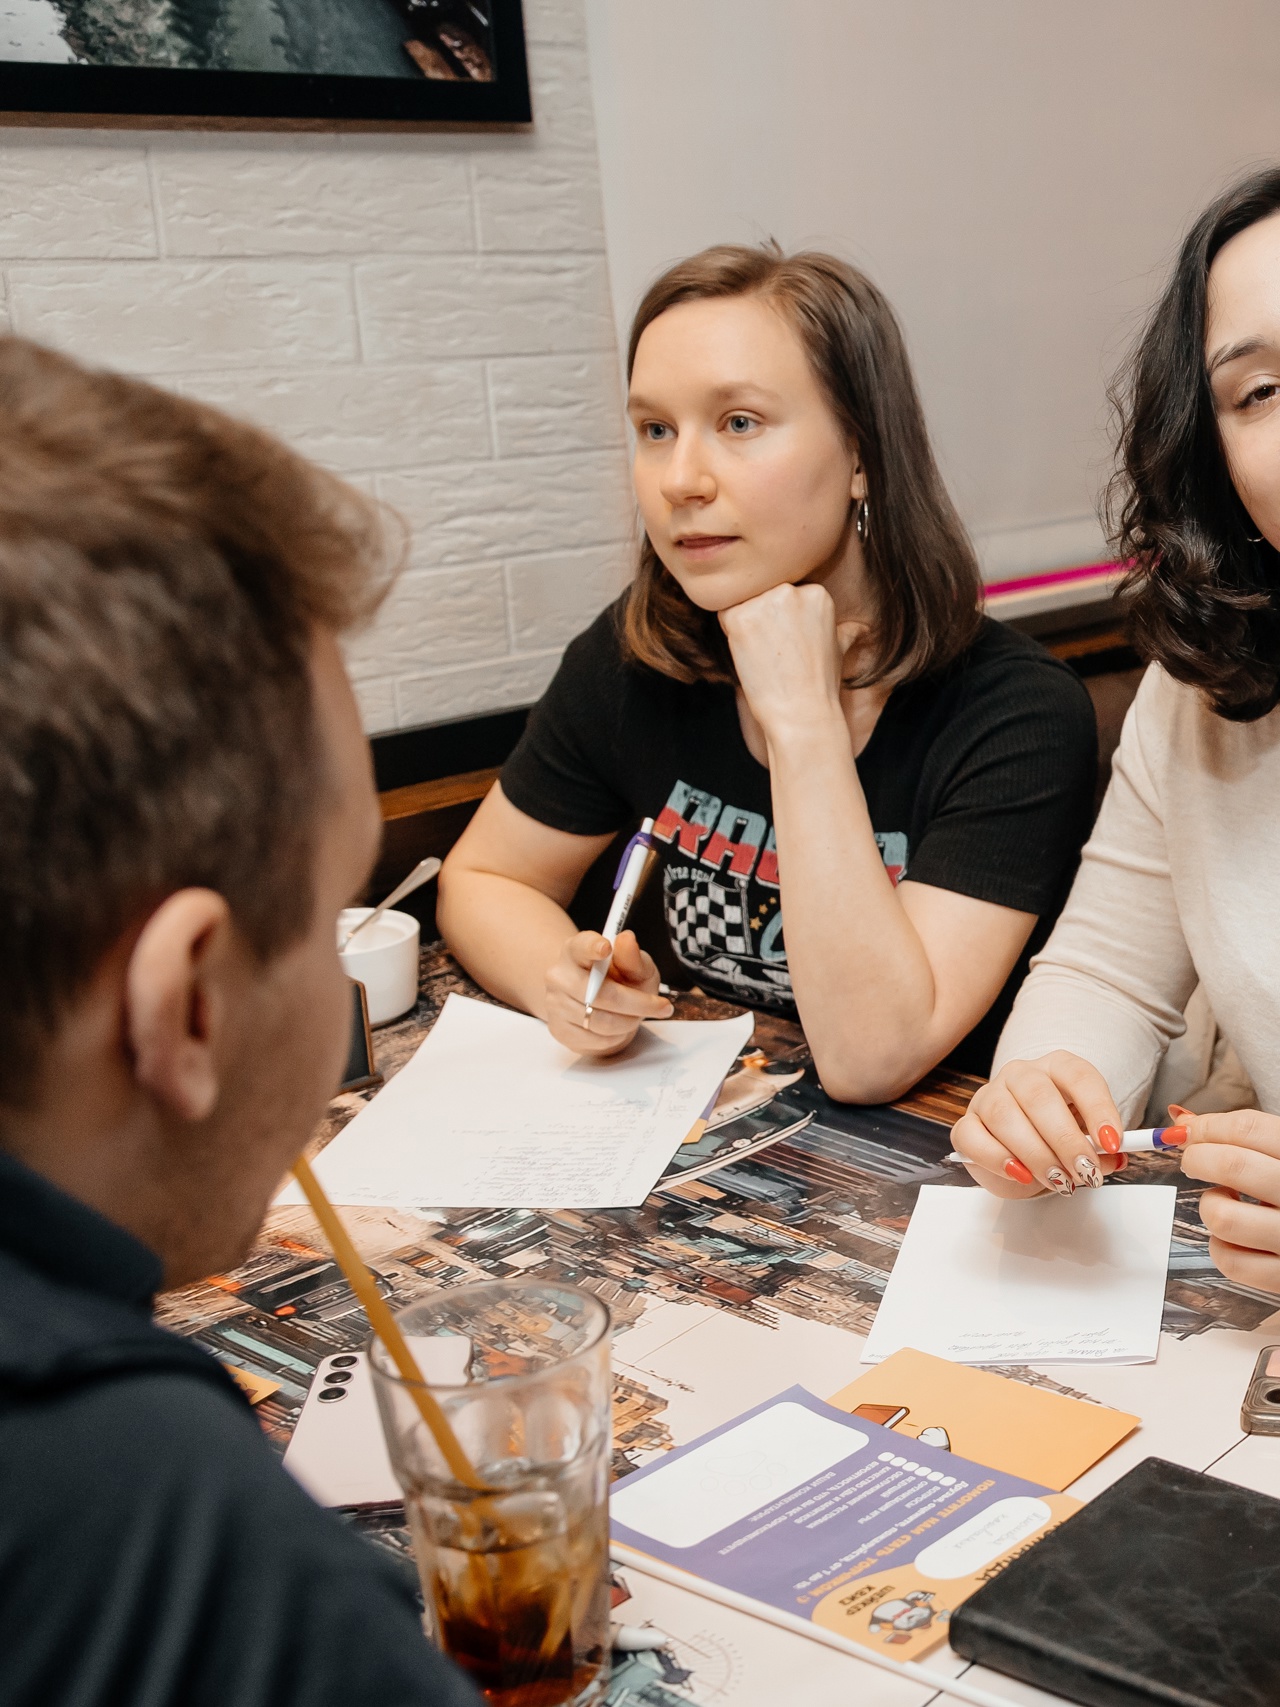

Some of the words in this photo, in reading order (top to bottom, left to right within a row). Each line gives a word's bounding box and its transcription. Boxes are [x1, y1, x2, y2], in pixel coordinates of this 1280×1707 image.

[810, 1471, 836, 1487] ВАШИ
[826, 1461, 879, 1491] ВЕРОЯТНОСТЬ,
[855, 1466, 891, 1488] КАЧЕСТВО
[880, 1476, 916, 1498] ВЕДУЩИЙ
[813, 1491, 830, 1501] ЧТО
[839, 1487, 857, 1498] ЕДЫ
[846, 1471, 904, 1506] ОБСЛУЖИВАНИЕ
[878, 1481, 928, 1512] ОРГАНИЗАЦИЯ
[904, 1485, 941, 1508] ВОПРОСЫ
[933, 1480, 969, 1503] Друзья,
[937, 1479, 996, 1518] ПОМОГИТЕ
[748, 1486, 812, 1522] КОММЕНТАРИИ:
[785, 1506, 803, 1517] НАС
[794, 1500, 835, 1524] НАПИТКОВ
[800, 1499, 815, 1508] ВЫ
[894, 1503, 936, 1527] оцените,
[805, 1504, 849, 1529] РЕСТОРАНА
[857, 1510, 881, 1524] ИГРЫ
[911, 1517, 939, 1535] НАМ
[839, 1527, 898, 1562] пожалуйста,
[876, 1534, 912, 1557] СТАТЬ
[808, 1572, 823, 1582] до
[829, 1562, 842, 1571] от
[839, 1585, 875, 1606] КВИЗ
[846, 1586, 895, 1615] ШЕЙКЕР
